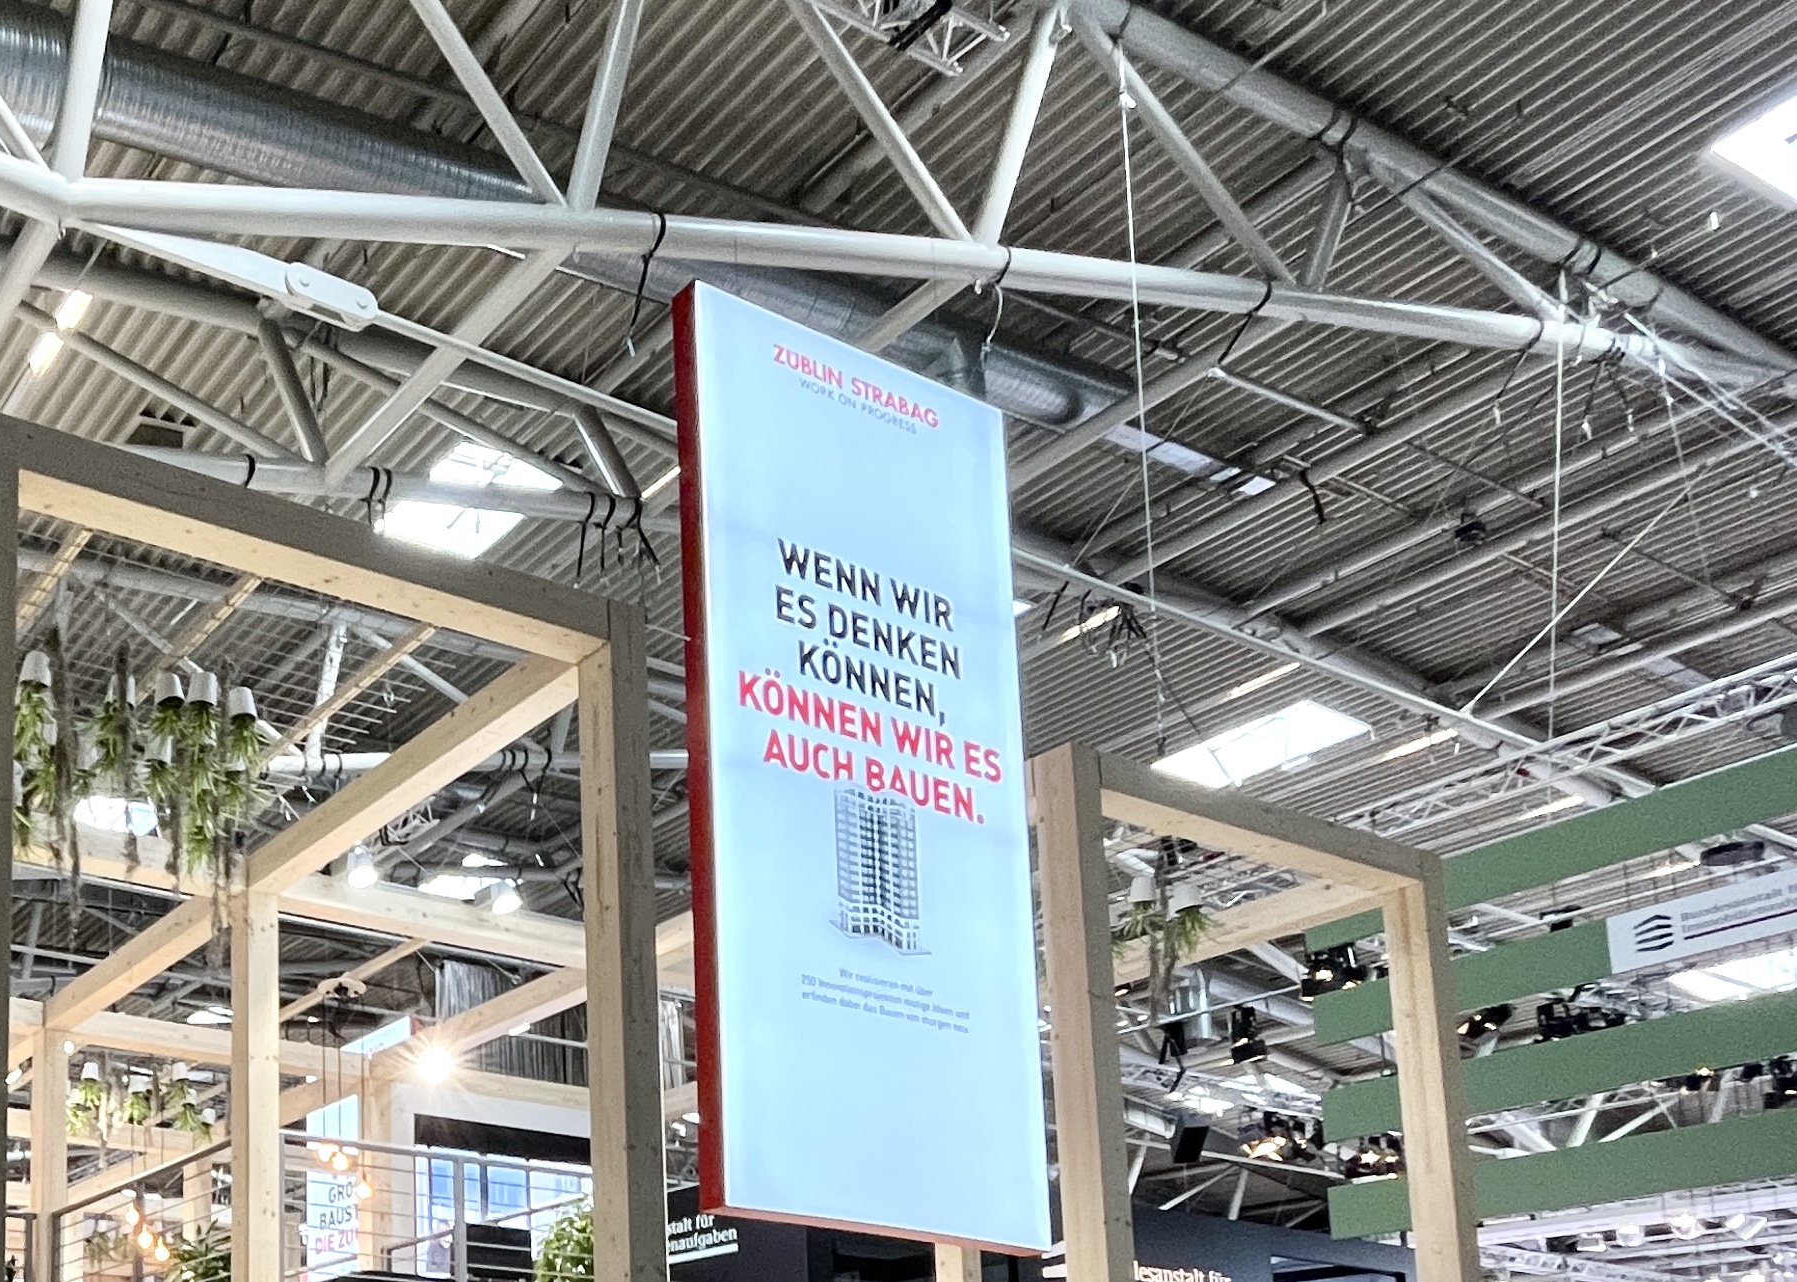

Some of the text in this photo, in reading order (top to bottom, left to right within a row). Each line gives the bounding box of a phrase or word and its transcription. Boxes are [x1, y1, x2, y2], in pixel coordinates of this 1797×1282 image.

[799, 378, 917, 435] WORK ON PROGRESS
[851, 377, 939, 428] STRABAG
[777, 537, 954, 632] WENN WIR
[775, 584, 961, 679] ES DENKEN
[738, 667, 1001, 783] KÖNNEN WIR ES
[798, 638, 945, 726] KÖNNEN,
[763, 729, 984, 824] AUCH BAUEN.
[695, 1214, 715, 1230] für
